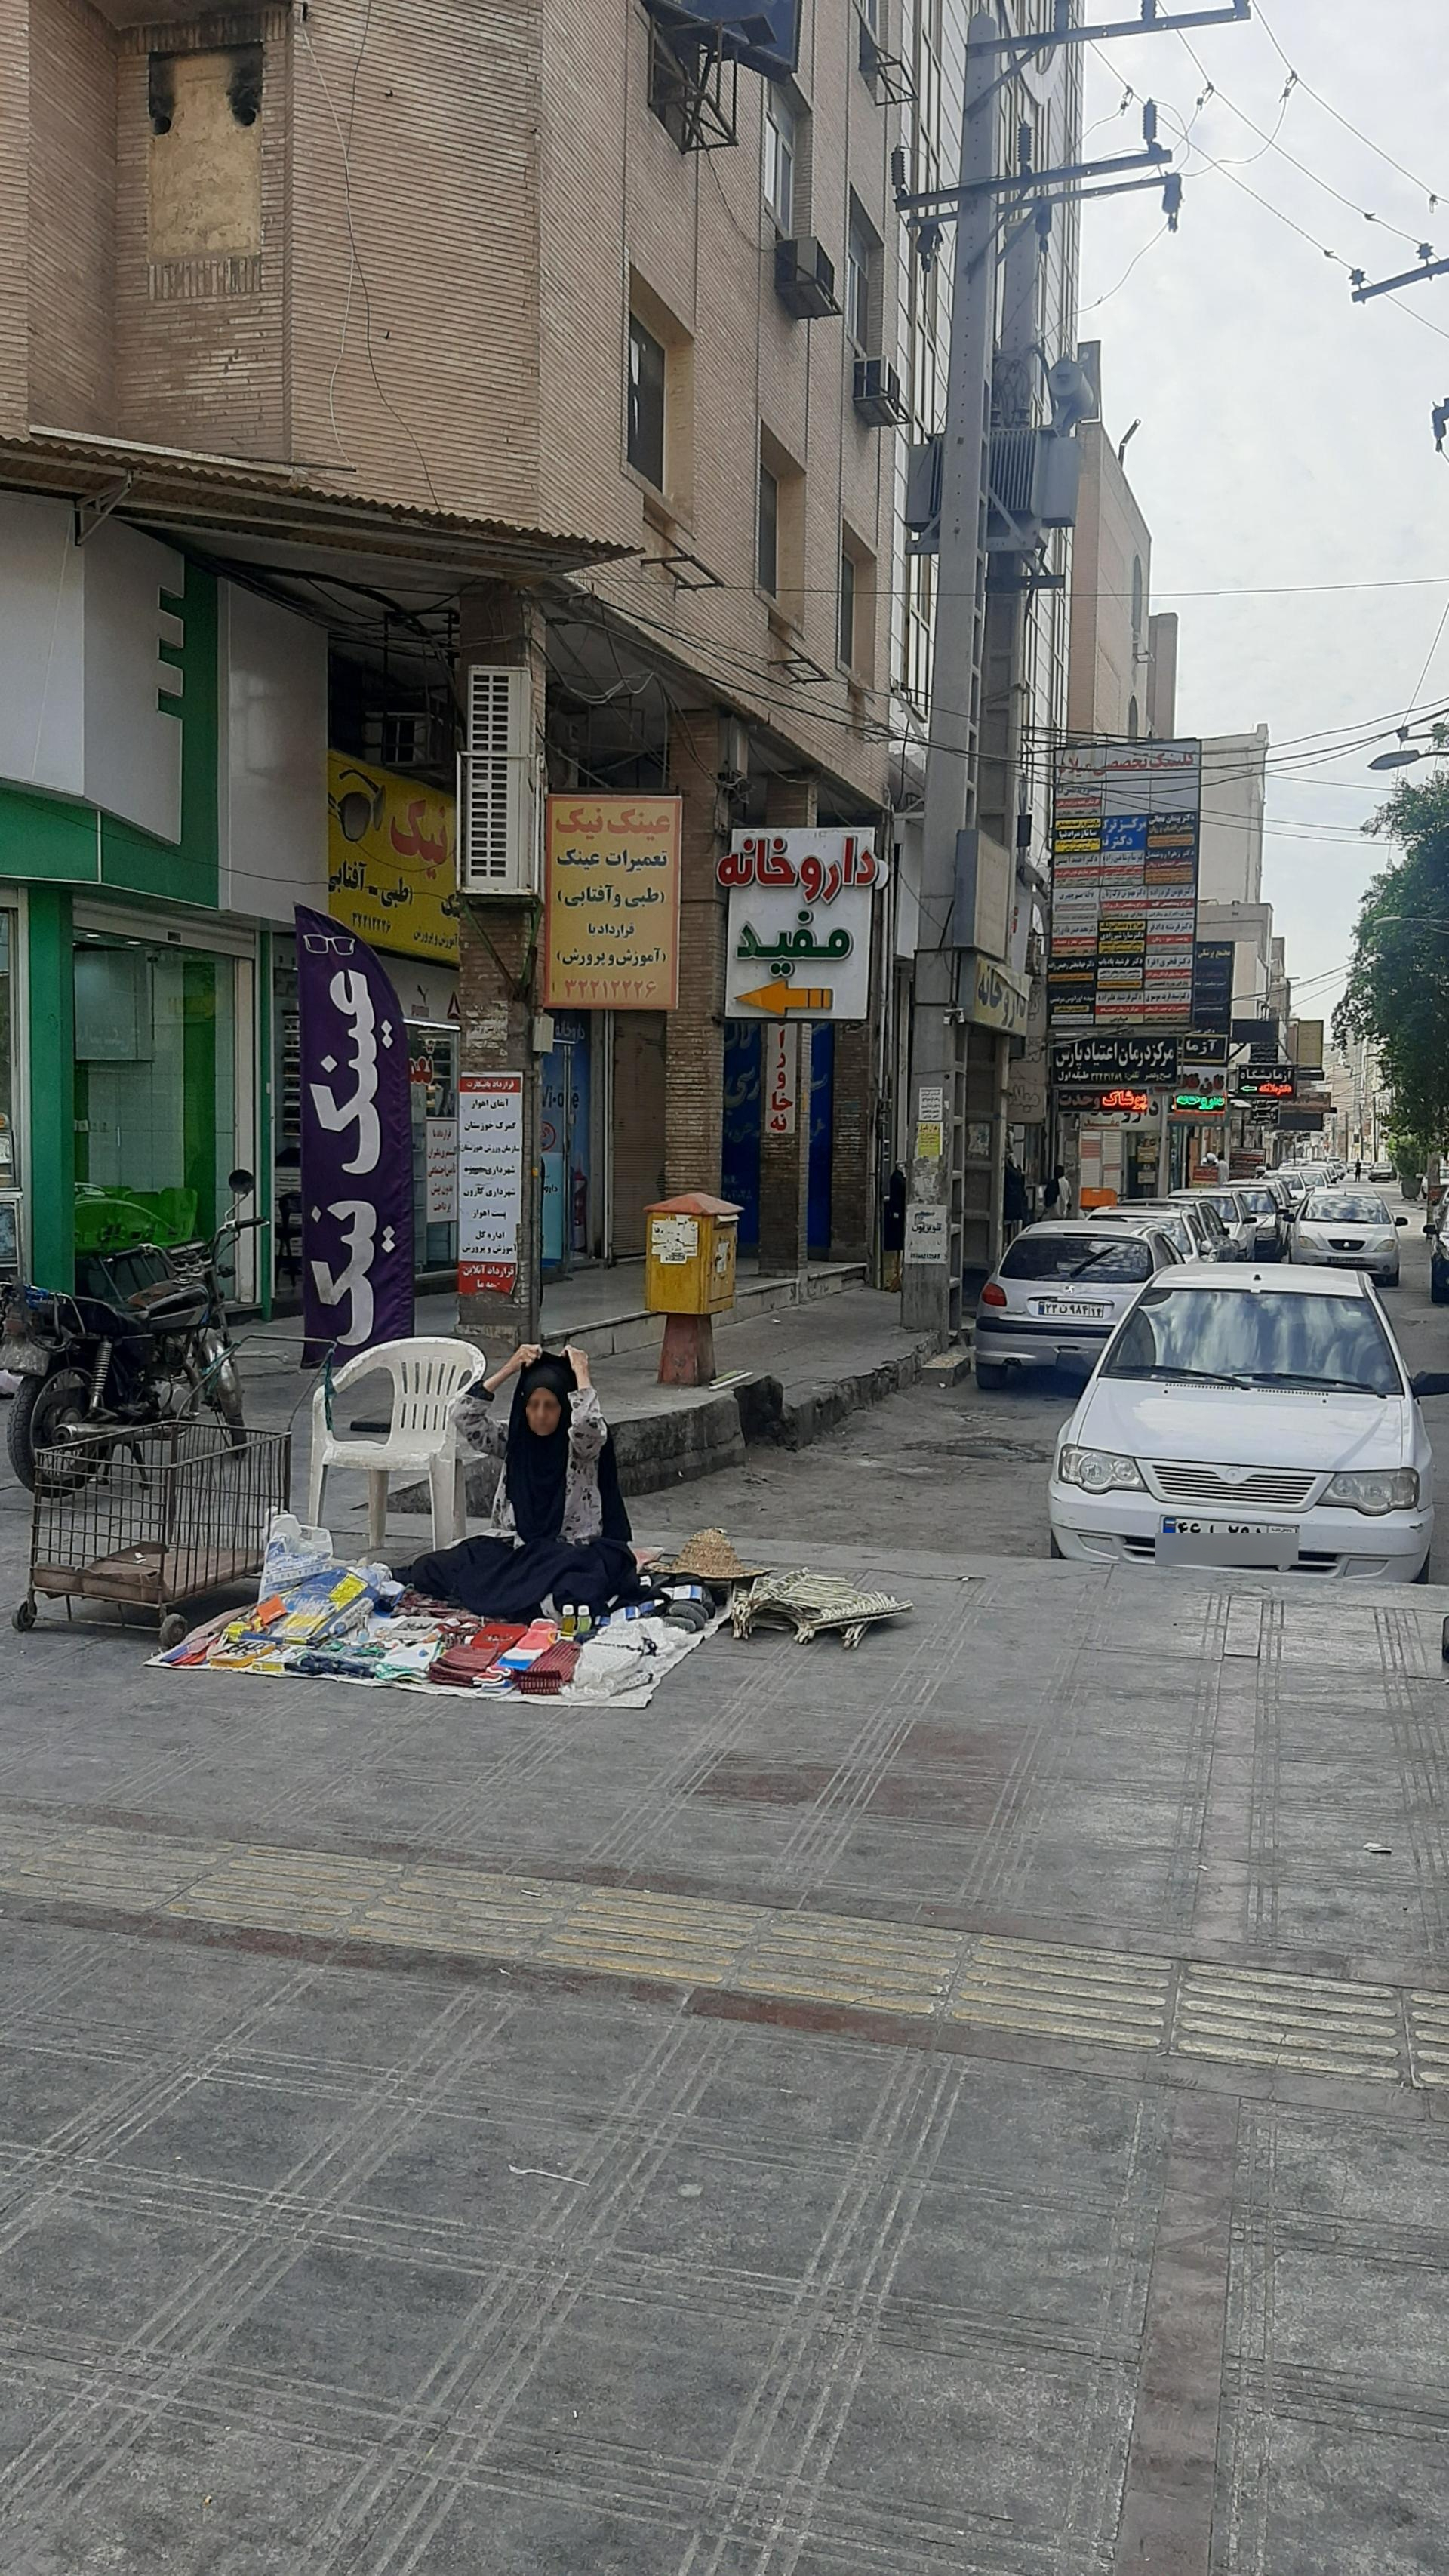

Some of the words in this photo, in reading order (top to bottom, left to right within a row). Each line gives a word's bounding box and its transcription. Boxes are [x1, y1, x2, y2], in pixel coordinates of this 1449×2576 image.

[555, 808, 604, 840] نیک
[607, 808, 671, 841] عینک
[1117, 818, 1146, 832] مرکز
[390, 799, 450, 880] نیک
[1111, 835, 1133, 849] دکتر
[557, 848, 600, 870] عینک
[605, 848, 667, 872] تعمیرات
[718, 836, 878, 904] داروخانه
[588, 923, 596, 935] با
[597, 923, 635, 939] قرارداد
[737, 909, 854, 977] مفید
[608, 954, 615, 967] و
[565, 980, 657, 999] ۳۲۲۱۲۲۲۶
[977, 965, 1026, 1029] داروخانه
[1056, 1042, 1084, 1070] پارس
[1084, 1041, 1118, 1066] اعتیاد
[1118, 1041, 1151, 1067] درمان
[1149, 1040, 1174, 1066] مرکز
[309, 968, 394, 1176] عینک
[1057, 1070, 1072, 1082] اول
[1072, 1070, 1089, 1082] طبقه
[1240, 1067, 1293, 1083] آزمایشگاه
[1058, 1093, 1101, 1110] وحدت
[1102, 1089, 1148, 1111] پوشاک
[463, 1120, 494, 1131] خوزستان
[495, 1122, 516, 1132] گمرک
[485, 1165, 516, 1176] شهرداری
[463, 1186, 485, 1197] کارون
[485, 1187, 516, 1198] شهرداری
[472, 1208, 491, 1219] اهواز
[475, 1230, 486, 1240] کل
[487, 1231, 505, 1242] اداره
[462, 1243, 485, 1254] پرورش
[309, 1199, 396, 1346] نیک
[462, 1265, 486, 1276] آنلاین
[487, 1265, 515, 1279] قرارداد
[1060, 1304, 1068, 1314] ن
